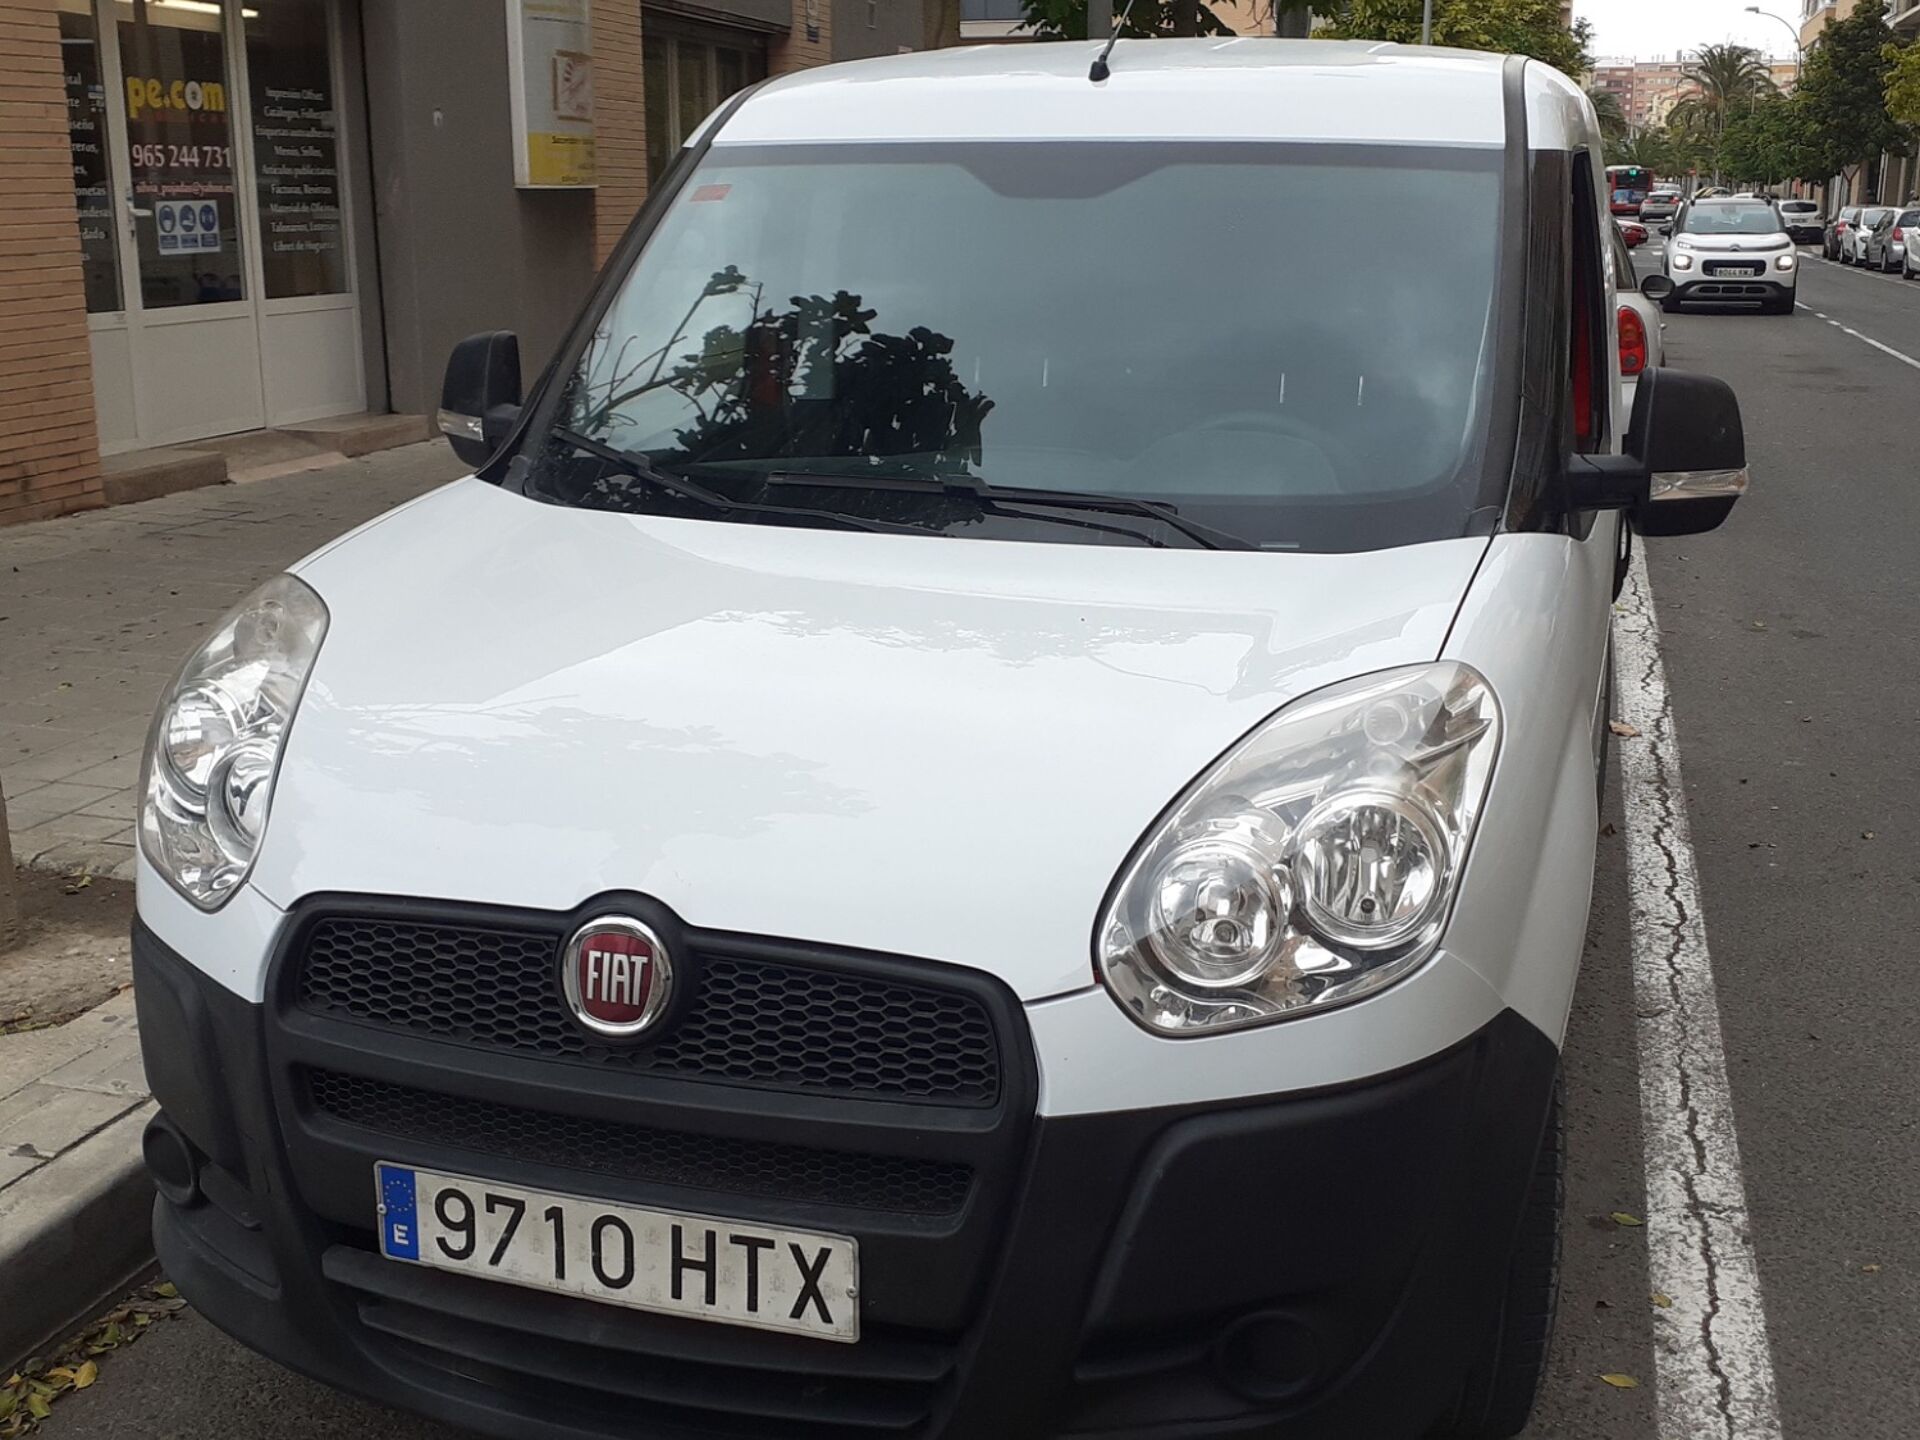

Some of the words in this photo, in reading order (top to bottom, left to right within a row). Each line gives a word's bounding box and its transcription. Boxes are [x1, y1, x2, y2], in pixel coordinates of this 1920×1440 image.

[126, 76, 225, 118] pe.com
[131, 144, 165, 168] 965
[167, 145, 200, 168] 244
[202, 146, 232, 168] 731
[586, 949, 648, 1006] FIAT
[393, 1223, 409, 1246] E
[434, 1187, 635, 1289] 9710
[670, 1224, 834, 1325] HTX
